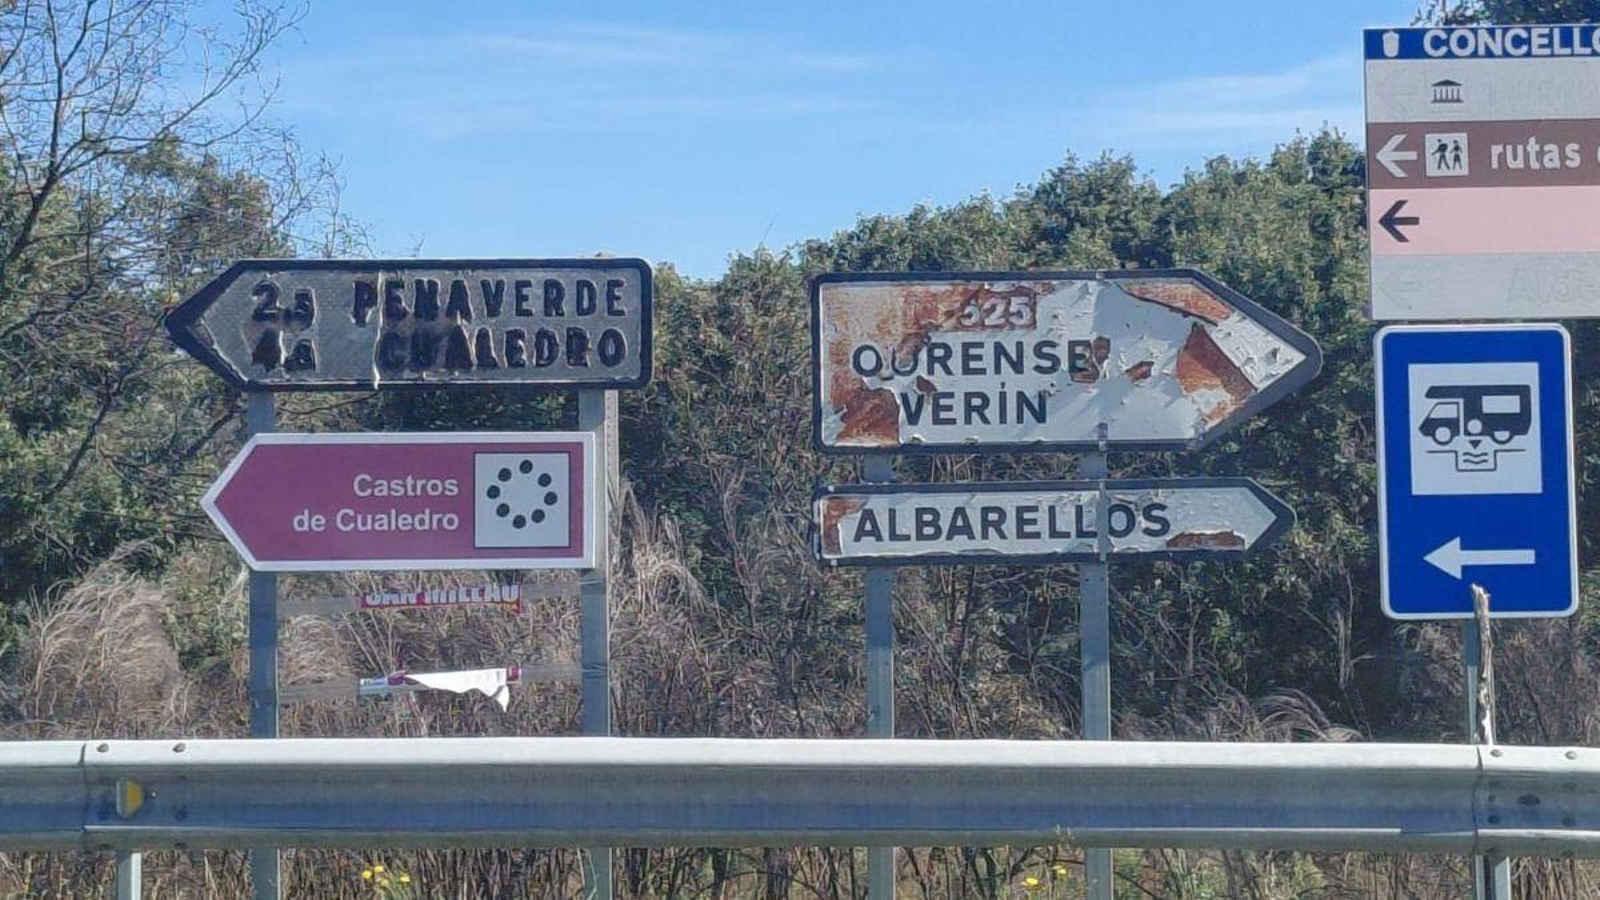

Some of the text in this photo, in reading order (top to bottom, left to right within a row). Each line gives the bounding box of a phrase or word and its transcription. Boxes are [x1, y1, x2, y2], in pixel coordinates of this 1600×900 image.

[1491, 135, 1581, 170] rutas
[852, 339, 1098, 378] OURENSE
[901, 381, 1048, 426] VERÍN
[353, 473, 459, 498] Castros
[293, 508, 459, 532] de Cualedro
[853, 502, 1171, 544] ALBARELLOS
